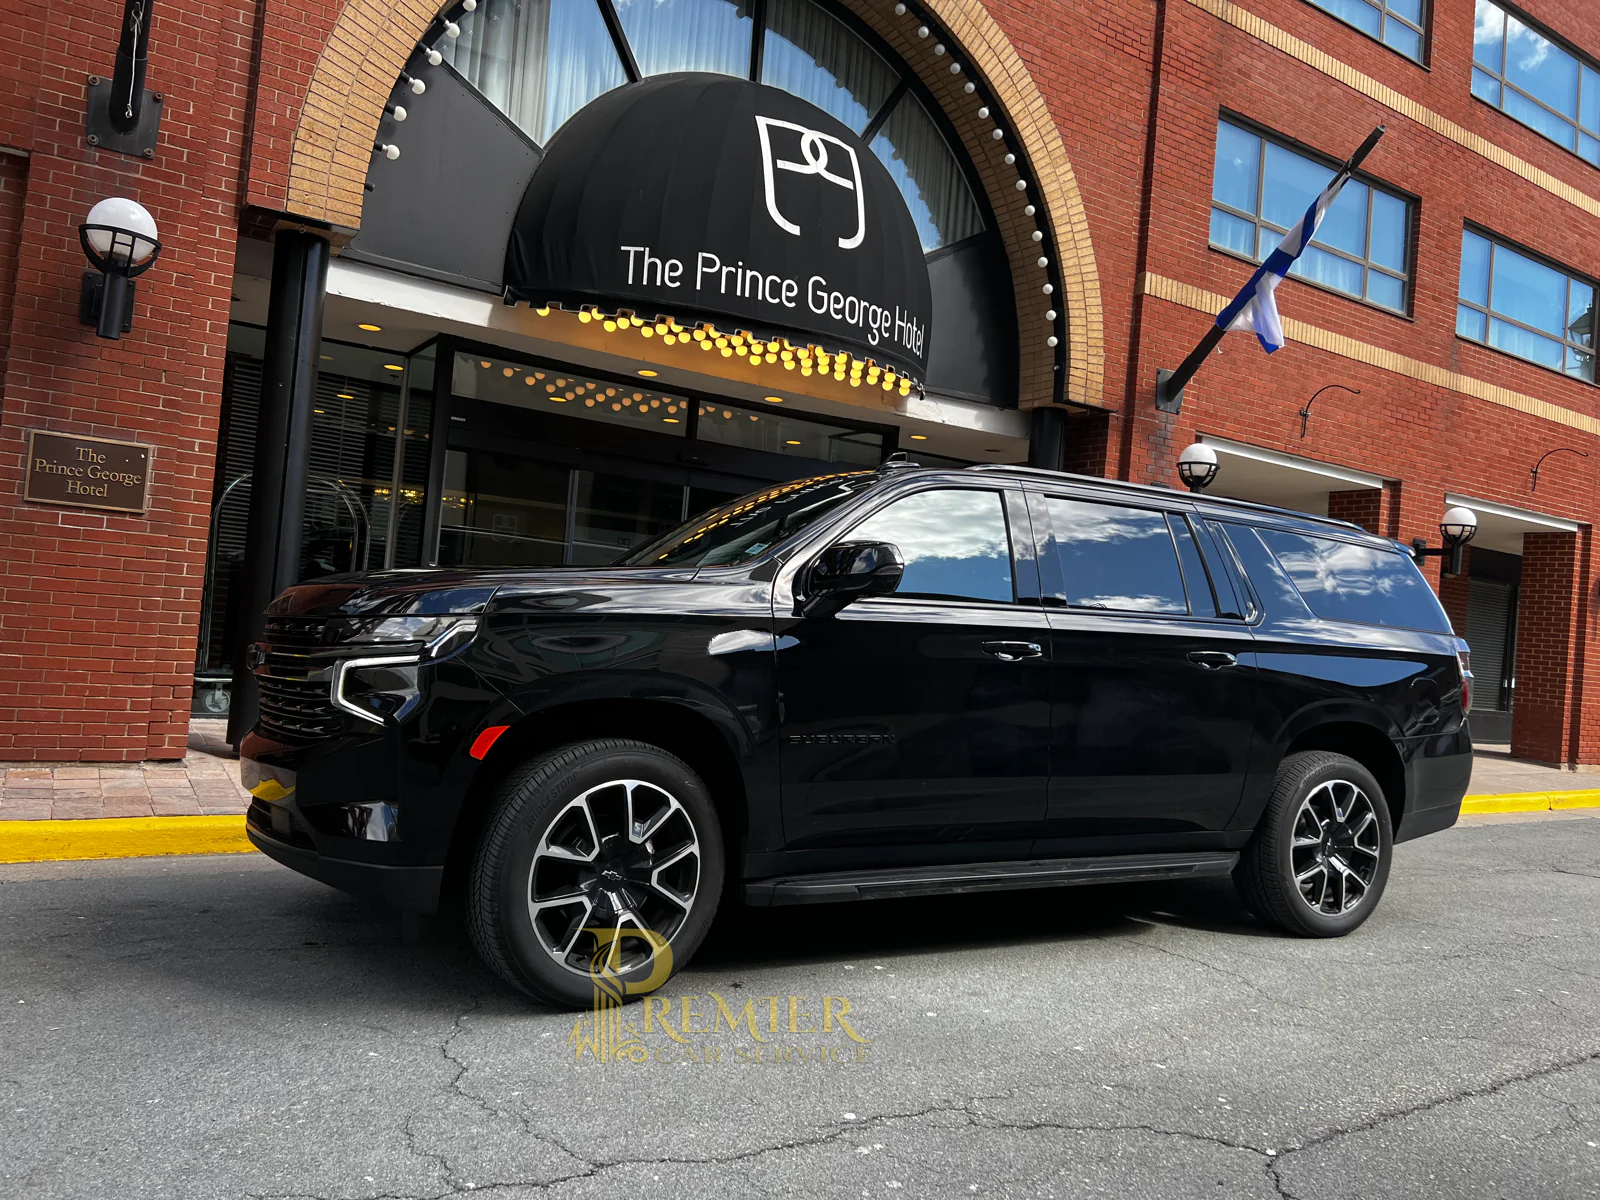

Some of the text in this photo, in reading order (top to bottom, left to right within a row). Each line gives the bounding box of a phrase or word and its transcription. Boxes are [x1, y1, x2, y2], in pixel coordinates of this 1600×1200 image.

[621, 246, 925, 358] The Prince George Hotel
[76, 447, 106, 464] The
[34, 458, 142, 487] Prince George
[65, 480, 108, 497] Hotel
[789, 734, 895, 744] SUBURBAN
